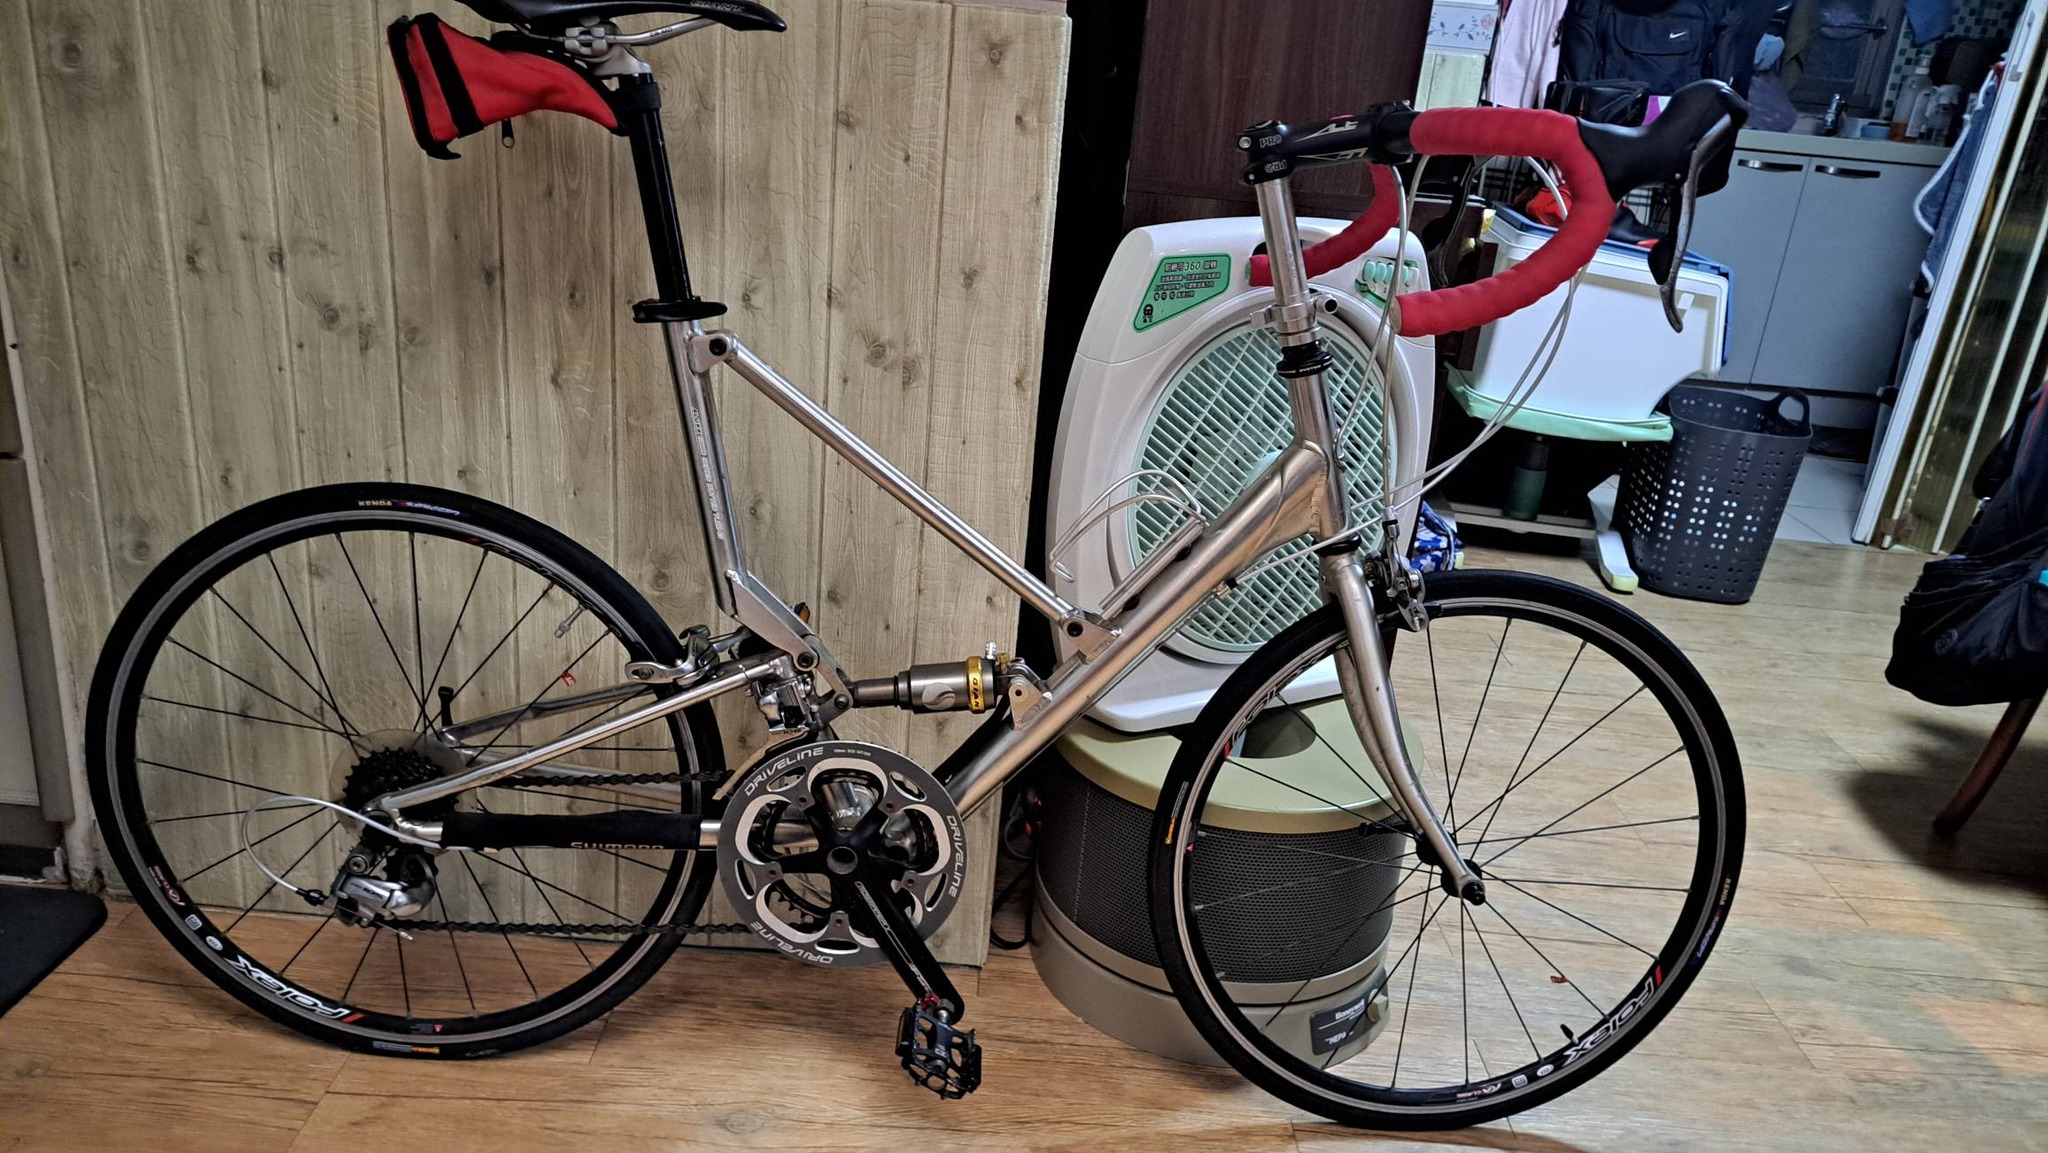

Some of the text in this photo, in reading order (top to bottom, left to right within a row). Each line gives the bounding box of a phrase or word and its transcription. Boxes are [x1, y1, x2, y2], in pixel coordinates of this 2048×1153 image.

[690, 1, 746, 13] GIANT
[1259, 134, 1283, 148] PRO
[357, 499, 393, 507] KENDA
[971, 677, 981, 711] GIAN
[744, 746, 826, 797] DRIVELINE
[946, 815, 965, 898] DRIVELINE
[1718, 877, 1732, 906] KENDA
[750, 920, 834, 965] DRIVELINE
